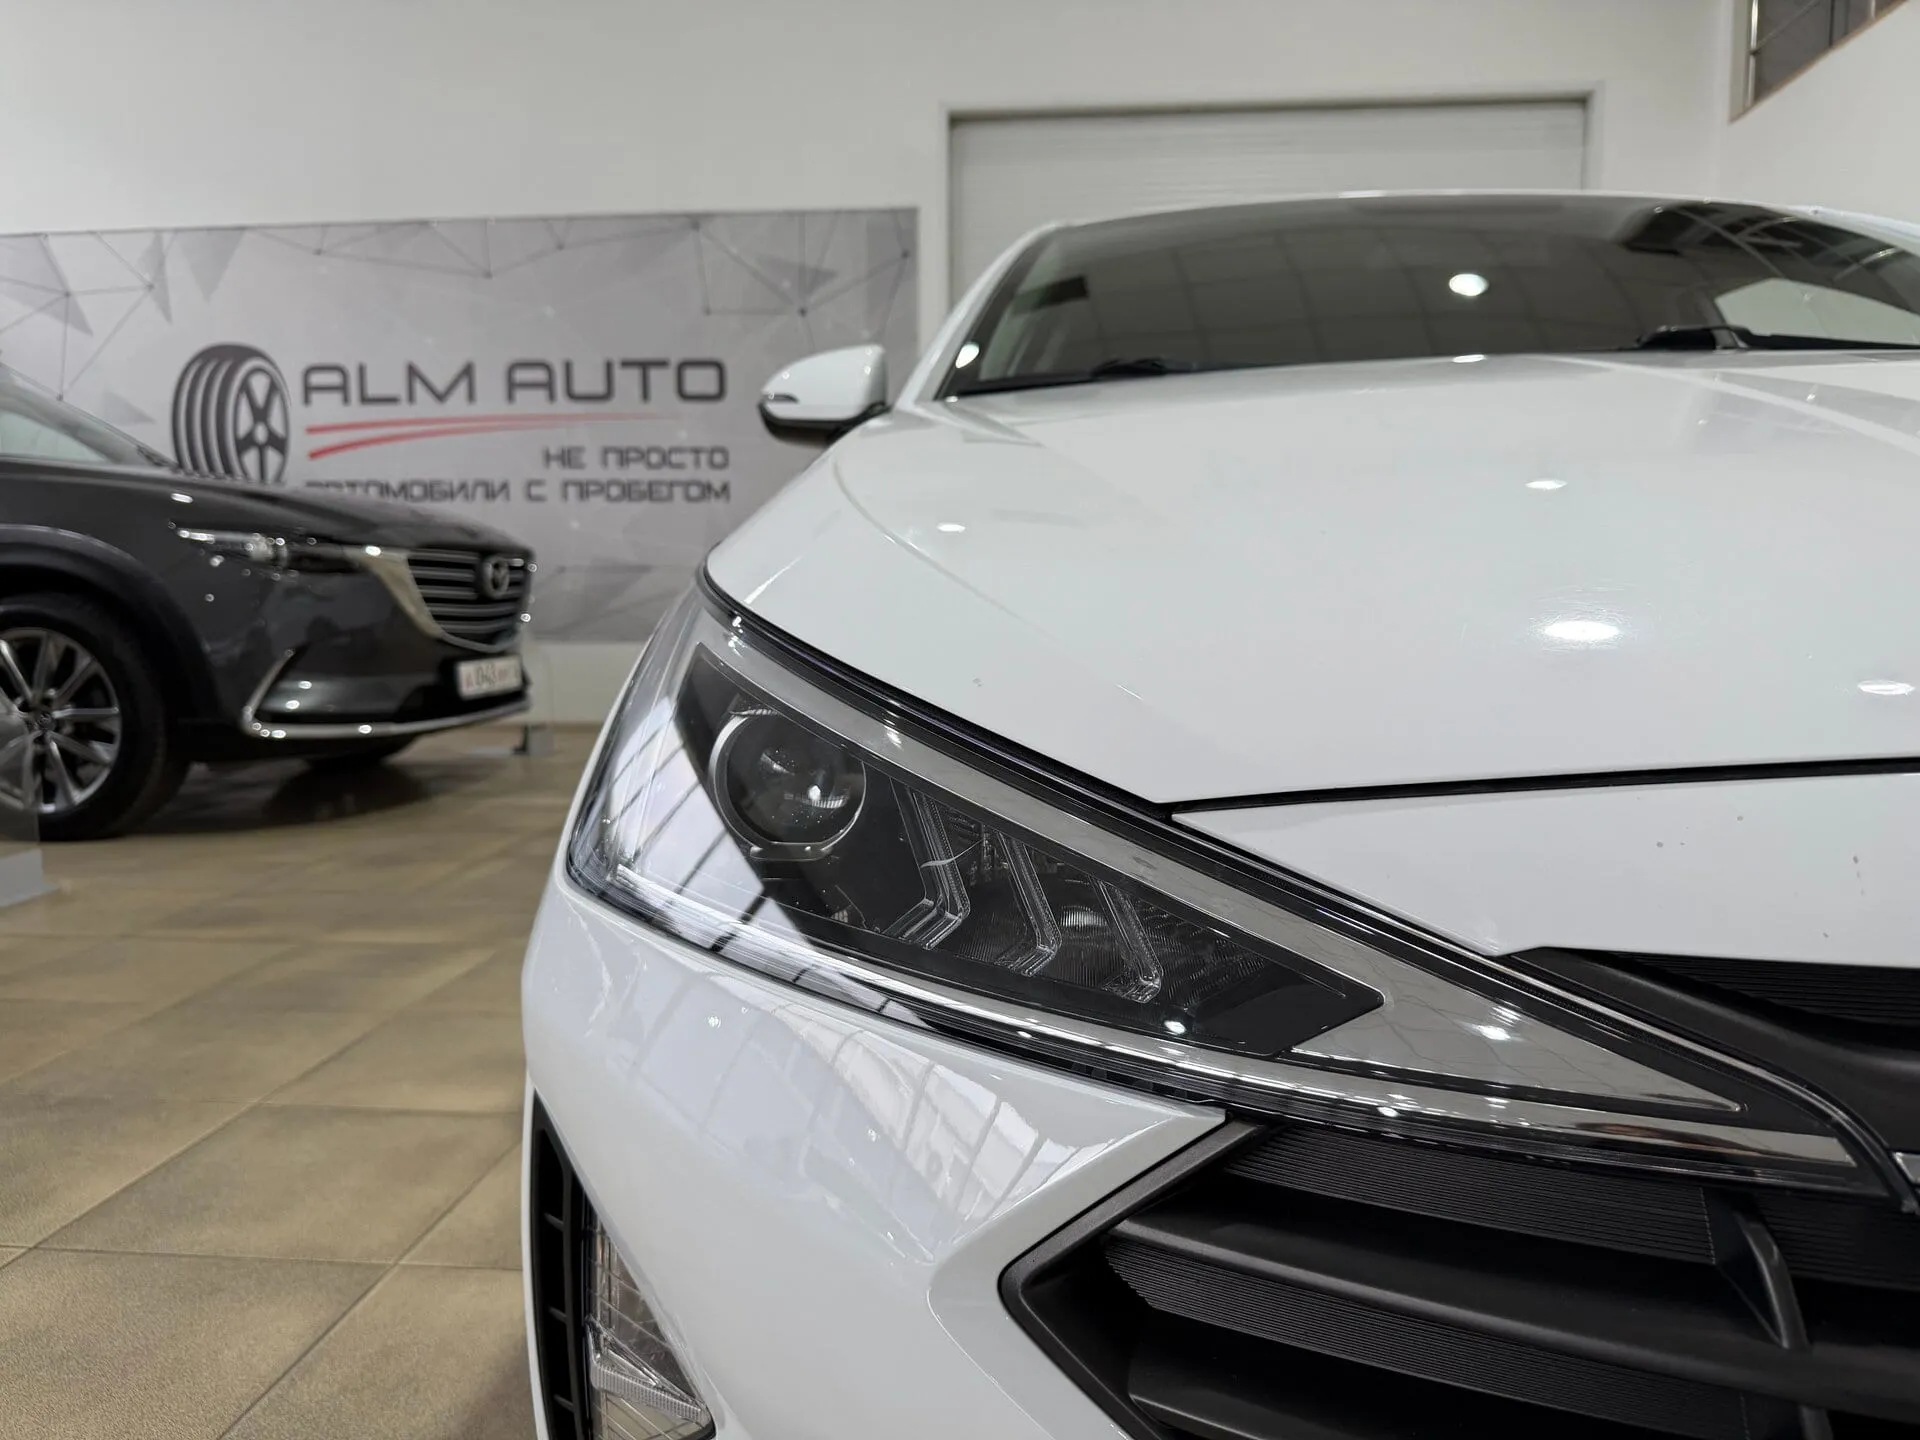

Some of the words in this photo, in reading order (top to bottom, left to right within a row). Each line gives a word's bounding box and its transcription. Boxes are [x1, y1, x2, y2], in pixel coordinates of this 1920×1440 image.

[301, 361, 477, 406] ALM
[506, 358, 728, 404] AUTO
[543, 446, 587, 470] НЕ
[601, 445, 730, 470] ПРОСТО
[525, 479, 548, 502] С
[562, 478, 731, 503] ПРОБЕГОМ
